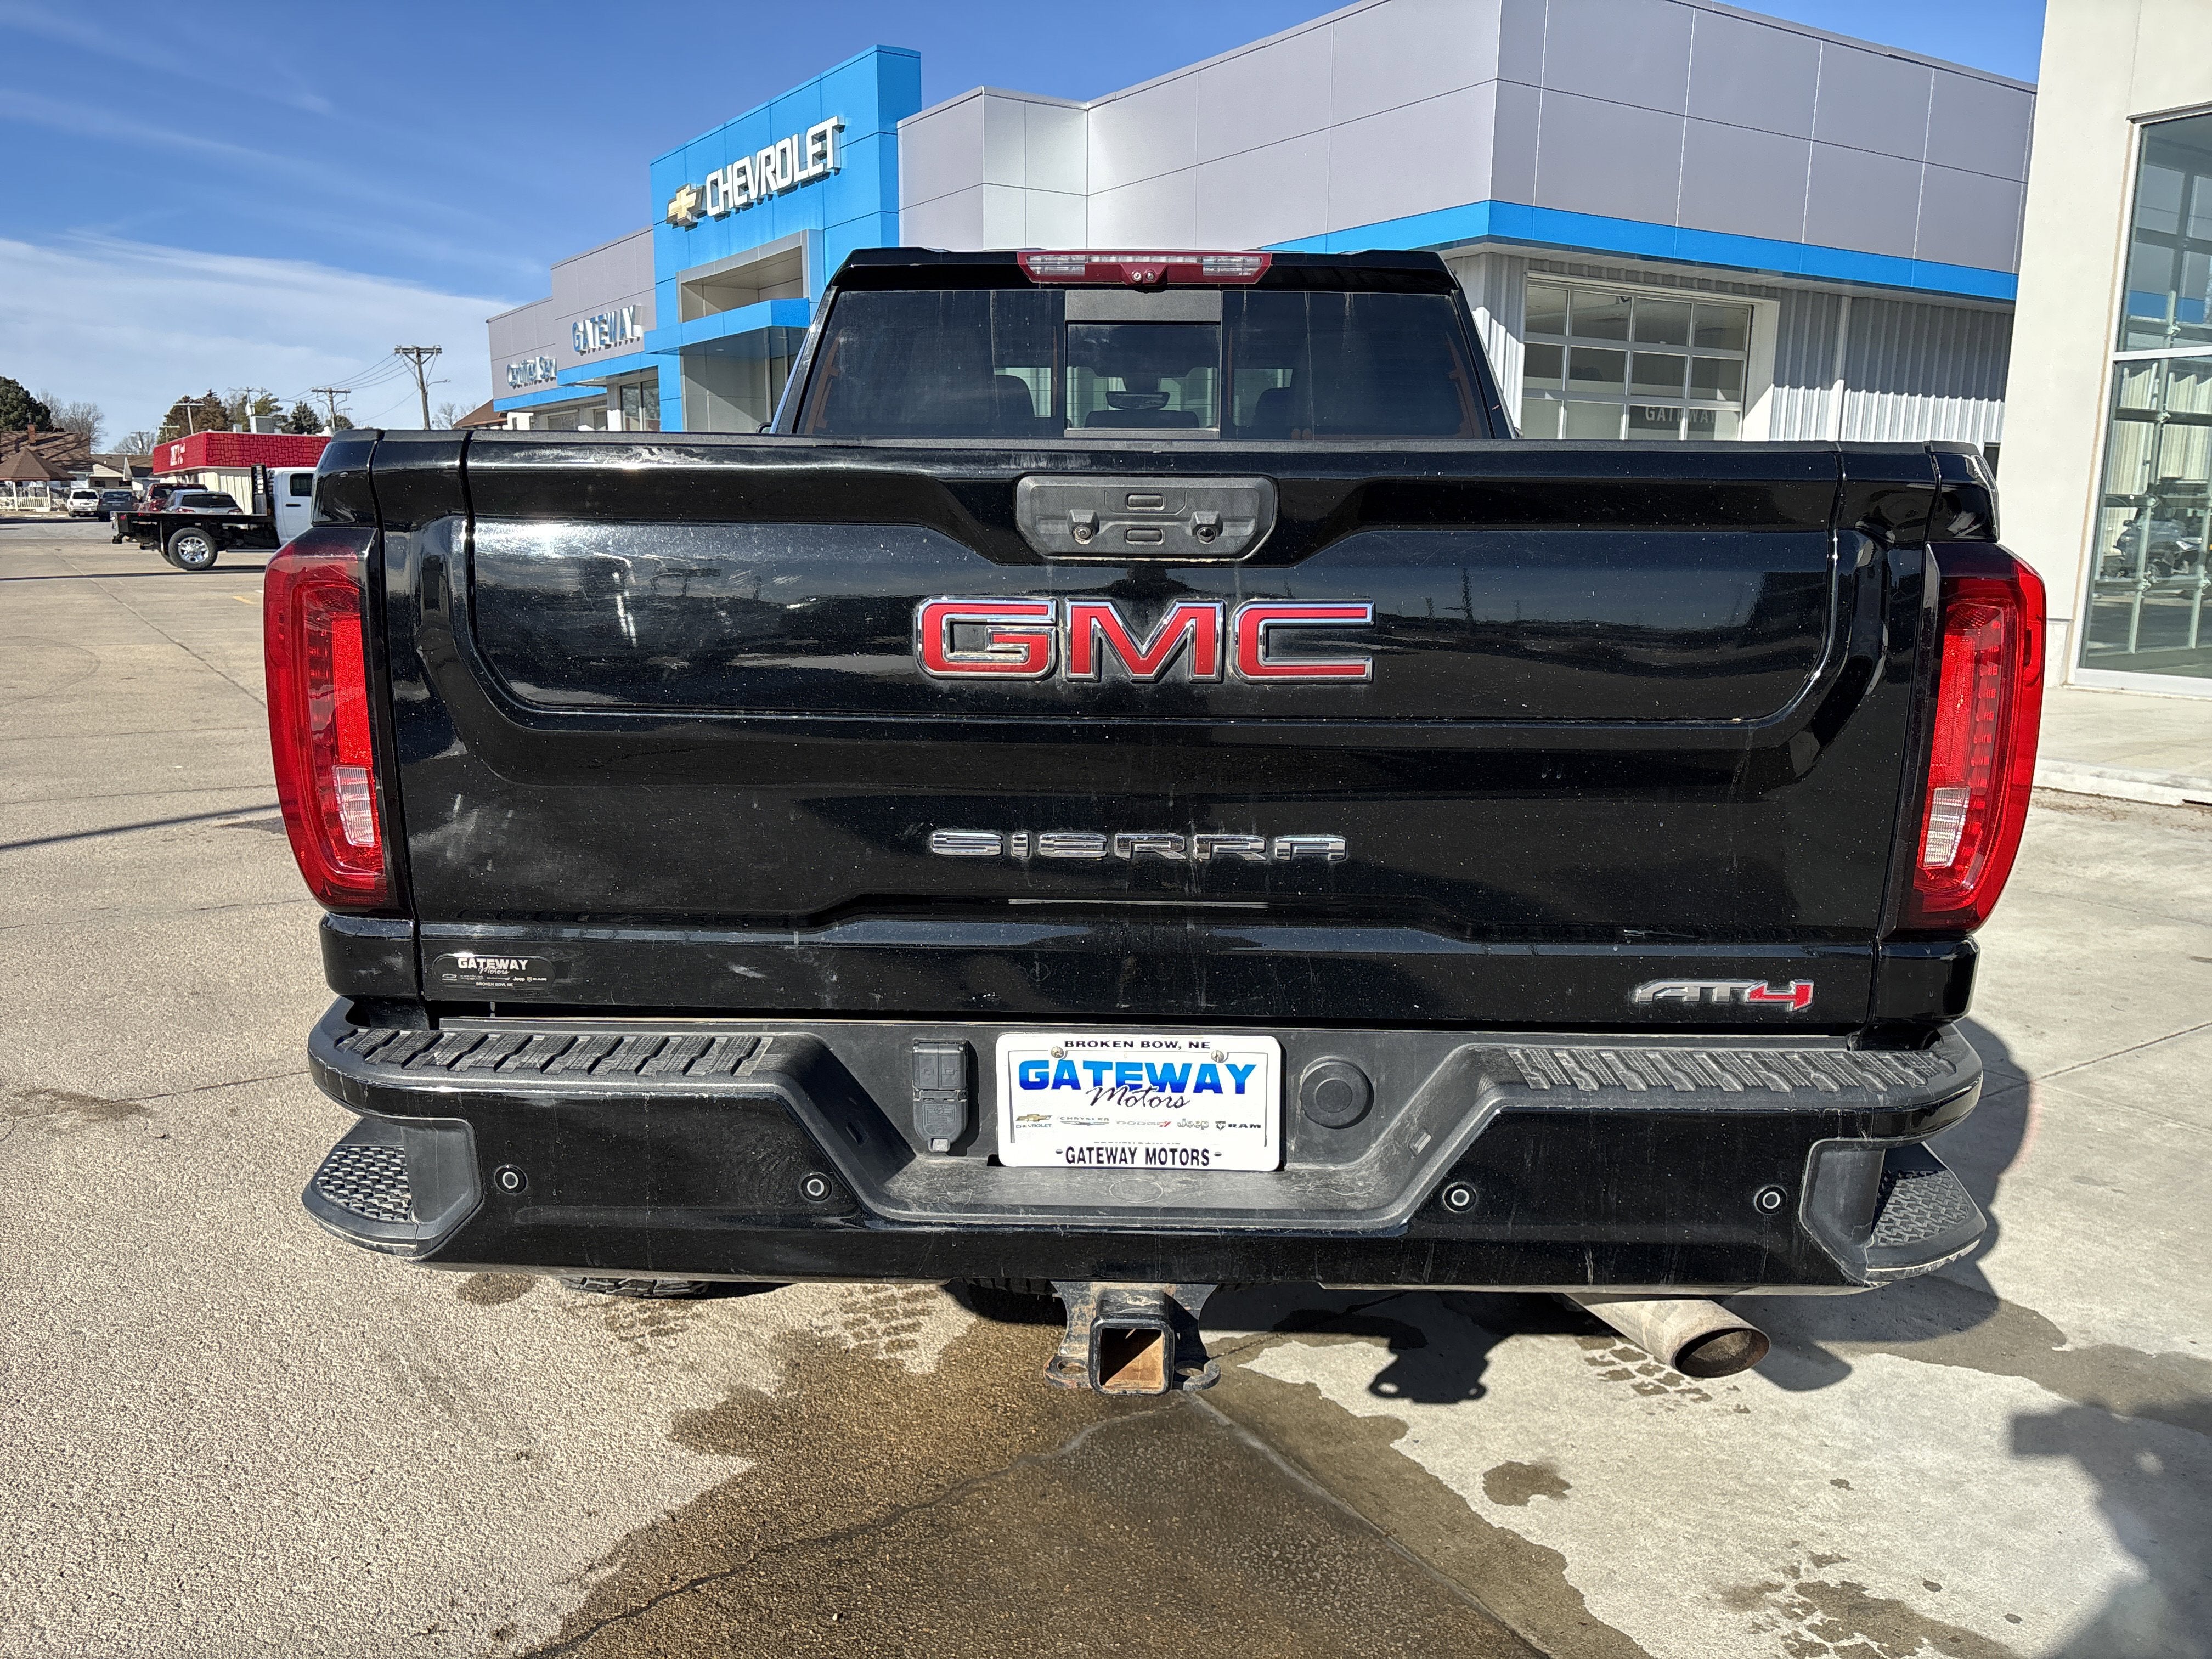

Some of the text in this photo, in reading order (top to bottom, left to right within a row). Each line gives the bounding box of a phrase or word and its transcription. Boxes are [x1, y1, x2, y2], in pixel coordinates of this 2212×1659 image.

[706, 115, 840, 217] CHEVROLET
[572, 305, 641, 352] GATEWAY
[916, 595, 1376, 684] GMC
[929, 830, 1348, 861] SIERRA
[458, 958, 528, 970] GATEWAY
[478, 966, 510, 975] Motors
[1635, 979, 1814, 1012] AT4
[1064, 1040, 1134, 1048] BROKEN
[1141, 1041, 1182, 1050] BOW,
[1019, 1060, 1257, 1094] GATEWAY
[1085, 1085, 1190, 1109] Motors
[1177, 1118, 1209, 1130] Jeep
[1065, 1146, 1210, 1166] GATEWAY MOTORS
